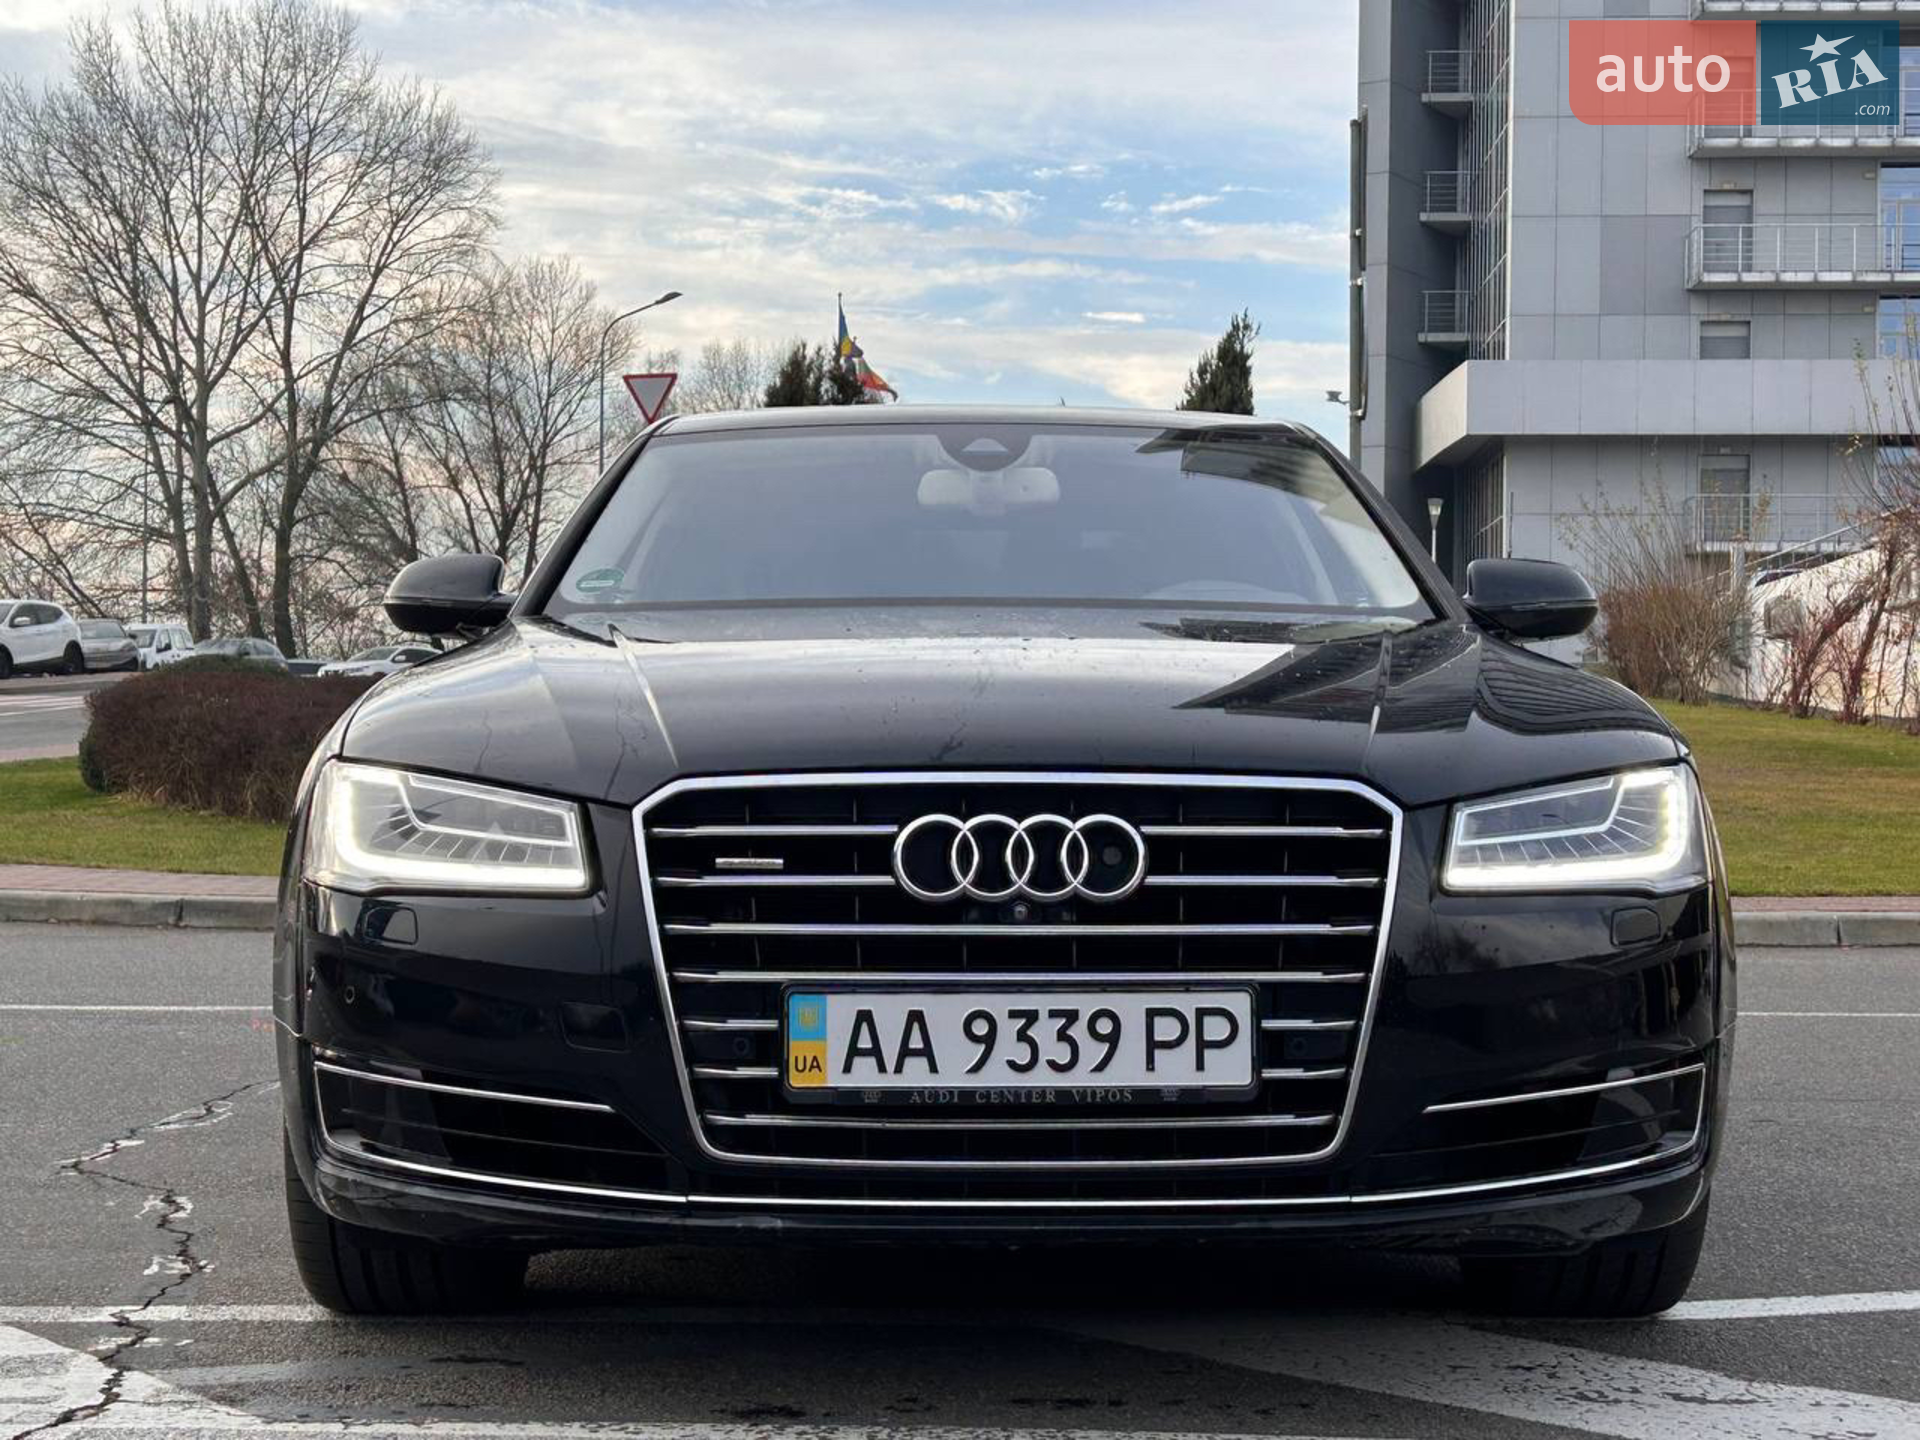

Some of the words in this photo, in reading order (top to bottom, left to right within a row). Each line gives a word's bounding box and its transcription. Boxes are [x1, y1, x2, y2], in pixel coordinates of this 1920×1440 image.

[842, 1008, 939, 1074] AA
[962, 1007, 1122, 1074] 9339
[1145, 1007, 1240, 1072] PP
[794, 1055, 823, 1073] UA
[909, 1089, 959, 1104] AUDI
[975, 1089, 1056, 1104] CENTER
[1071, 1088, 1133, 1103] VIPOS
